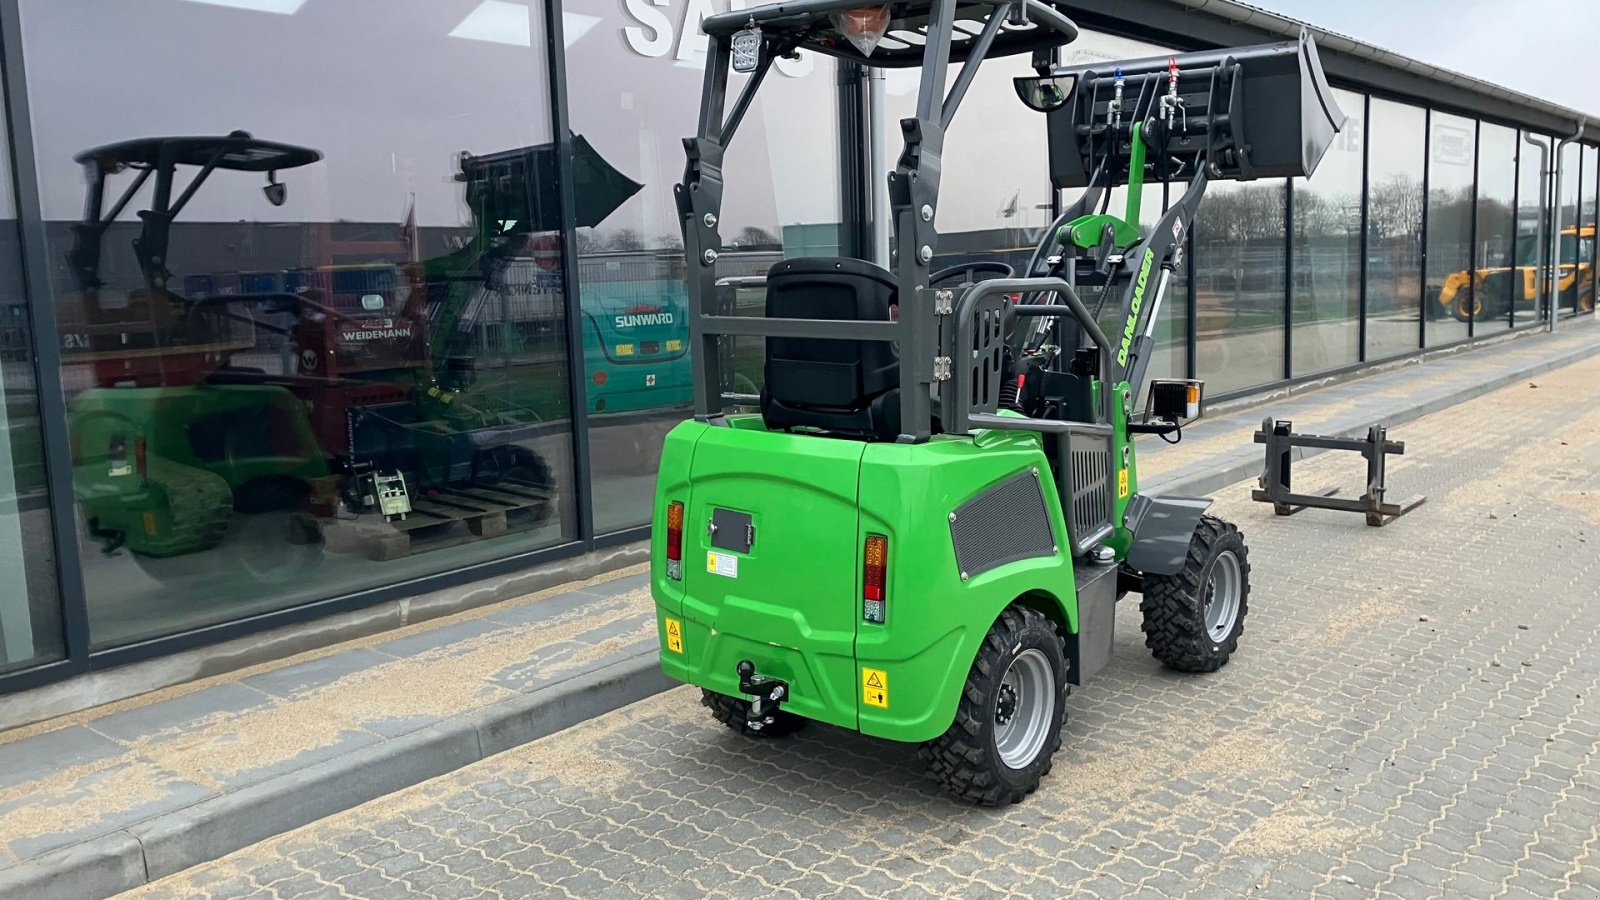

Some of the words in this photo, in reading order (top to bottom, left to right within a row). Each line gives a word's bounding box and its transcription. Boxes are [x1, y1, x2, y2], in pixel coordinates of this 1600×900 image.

[1117, 247, 1154, 368] DANLOADER
[615, 312, 673, 328] SUNWARD
[342, 328, 411, 341] WEIDEMANN
